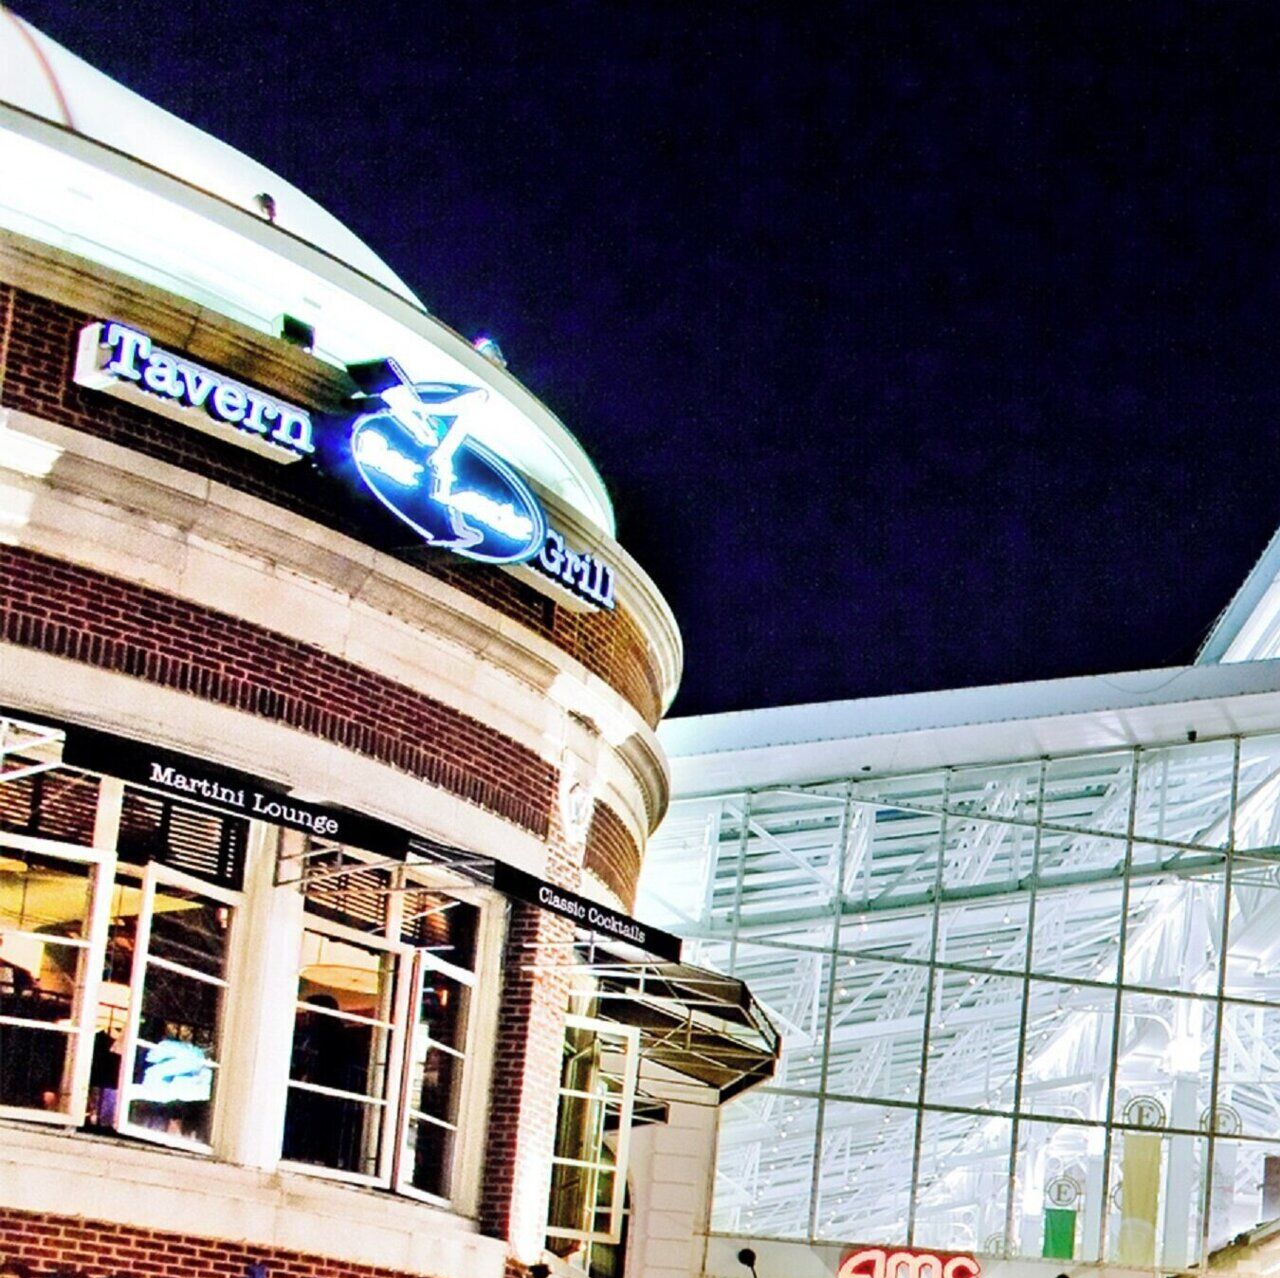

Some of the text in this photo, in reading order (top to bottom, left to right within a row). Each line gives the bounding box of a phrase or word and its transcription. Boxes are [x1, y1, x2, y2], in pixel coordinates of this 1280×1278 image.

[107, 323, 315, 454] Tavern
[540, 529, 615, 609] Grill
[149, 762, 339, 834] Martini Lounge
[539, 887, 646, 943] Classic Cocktails
